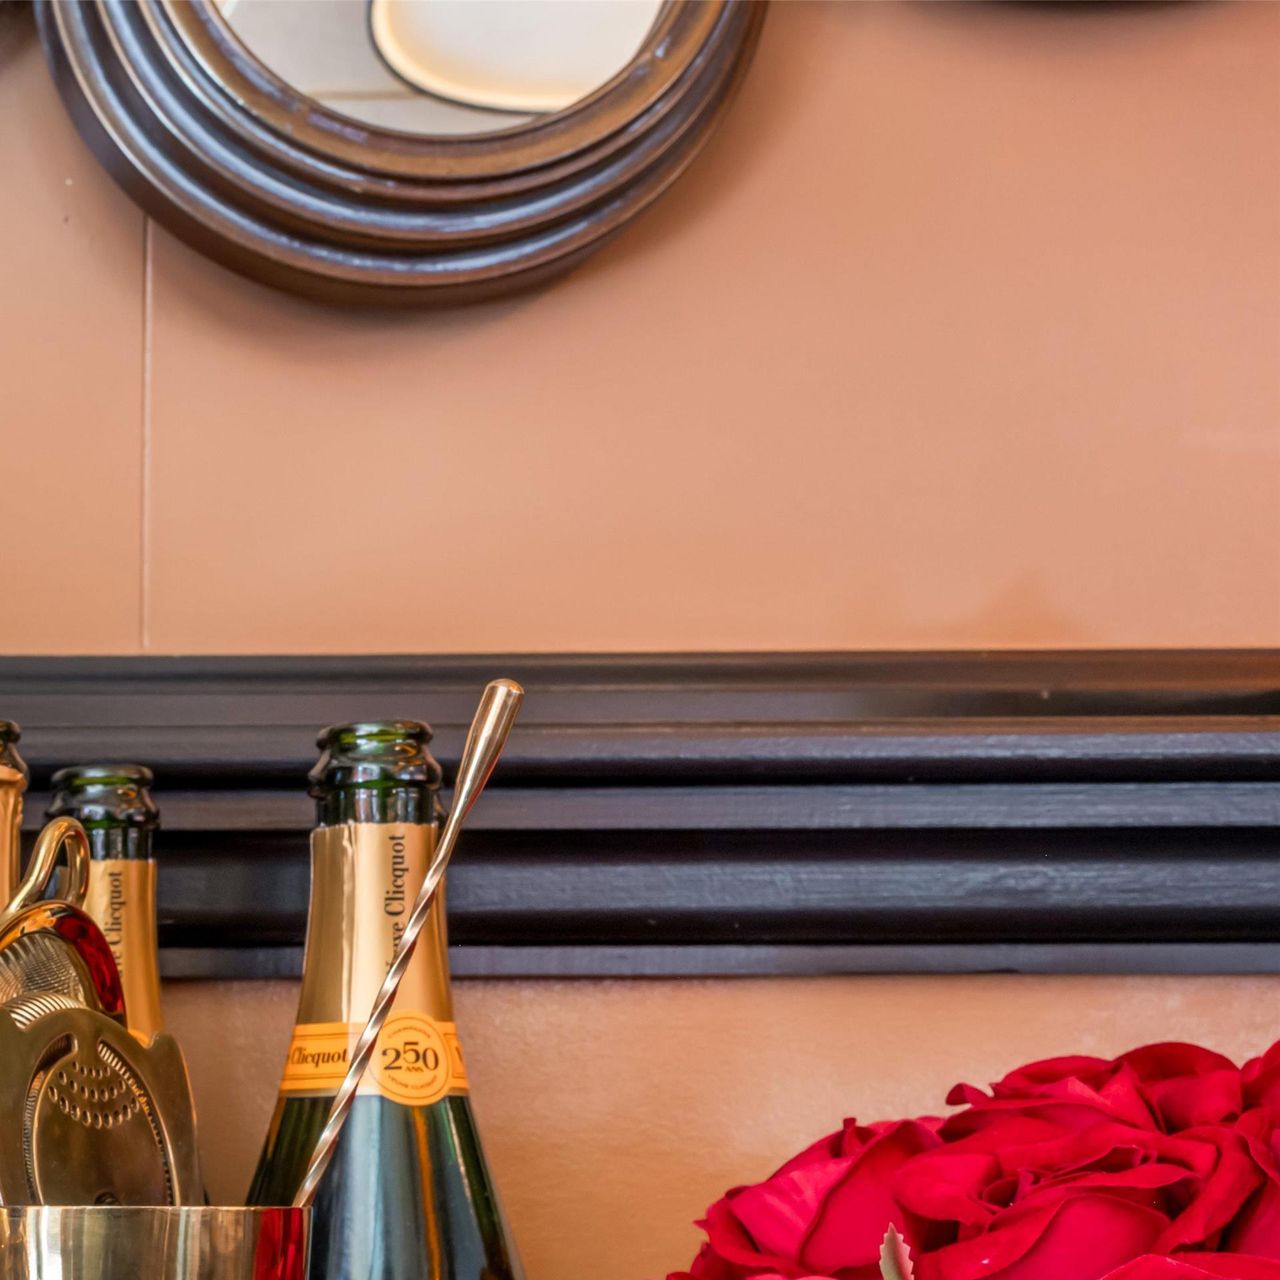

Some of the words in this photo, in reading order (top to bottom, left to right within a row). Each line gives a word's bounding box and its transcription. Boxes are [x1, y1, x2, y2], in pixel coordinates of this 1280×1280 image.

[384, 834, 409, 916] Clicquot
[104, 872, 125, 945] Clicquot
[290, 1045, 348, 1068] Clicquot
[381, 1041, 439, 1071] 250
